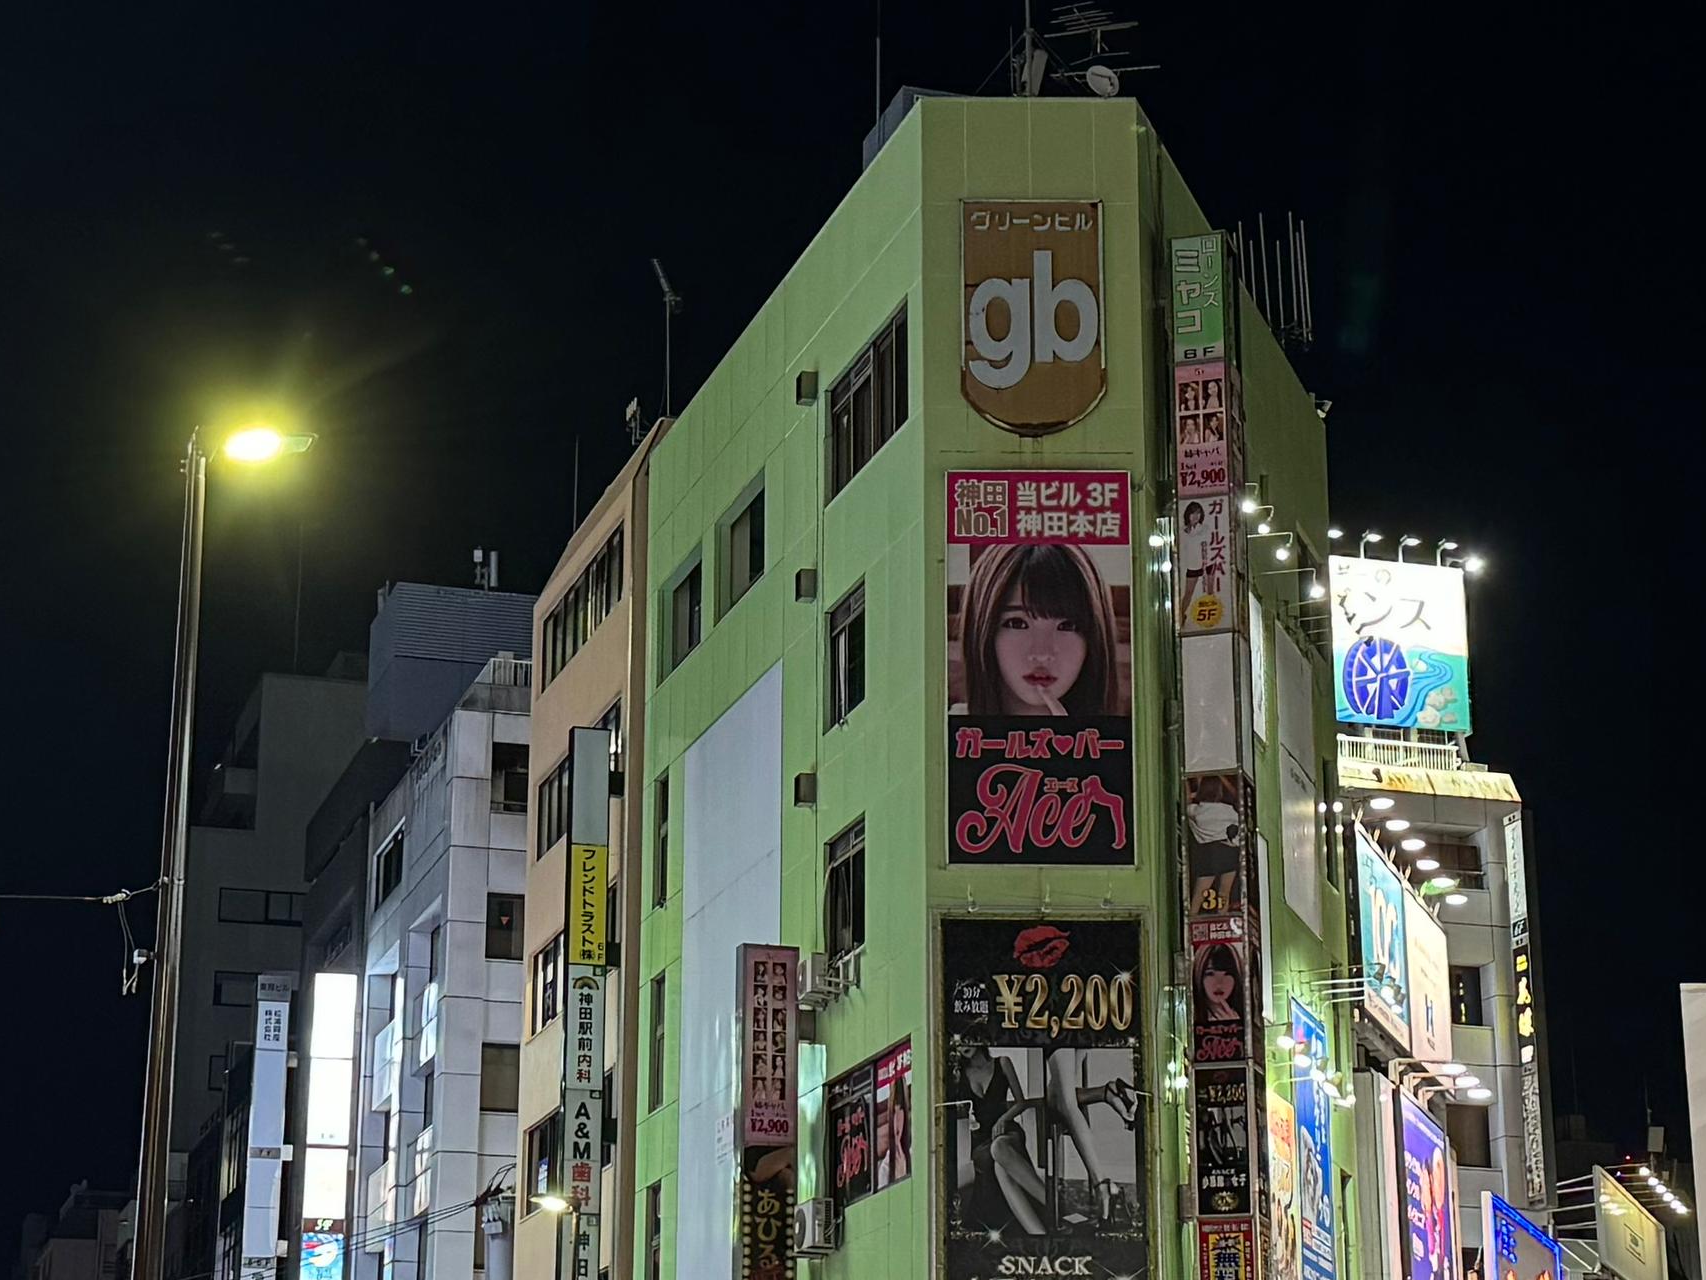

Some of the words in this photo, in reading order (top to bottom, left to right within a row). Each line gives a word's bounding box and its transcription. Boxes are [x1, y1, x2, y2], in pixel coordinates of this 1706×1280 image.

[970, 210, 1093, 233] グリーンビル
[1175, 248, 1202, 335] ミヤコ
[968, 250, 1099, 389] gb
[955, 480, 1009, 507] 神田
[1016, 481, 1081, 508] 当ビル
[1086, 483, 1121, 508] 3F
[955, 507, 1009, 537] No.1
[1016, 511, 1122, 538] 神田本店
[992, 974, 1133, 1039] ¥2,200
[576, 992, 593, 1083] 神田駅前内科
[998, 1255, 1092, 1276] SNACK
